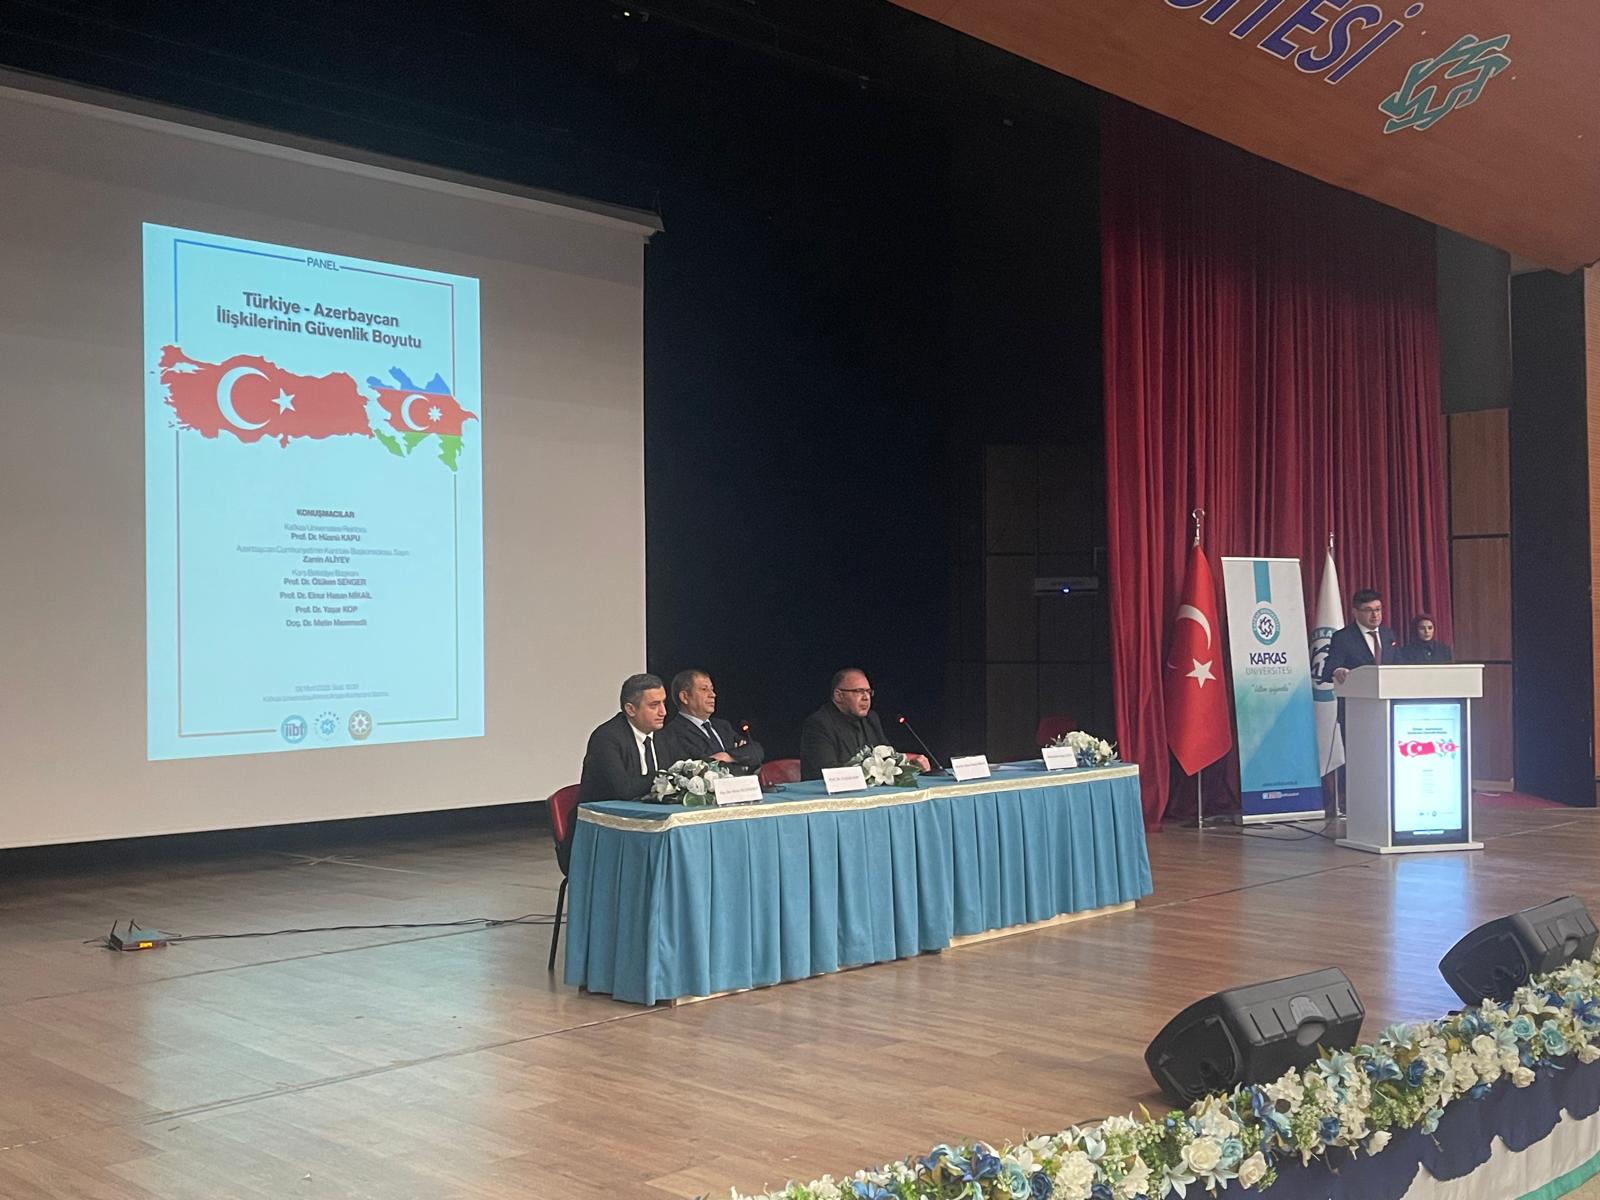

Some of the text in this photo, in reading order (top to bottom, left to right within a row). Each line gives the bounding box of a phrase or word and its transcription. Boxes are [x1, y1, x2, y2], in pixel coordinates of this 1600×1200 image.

[306, 257, 339, 271] PANEL
[242, 291, 301, 314] Türkiye
[313, 302, 399, 328] Azerbaycan
[216, 305, 422, 349] İlişkilerinin Güvenlik Boyutu
[296, 509, 355, 519] KONUŞMACILAR
[290, 533, 306, 541] Prof.
[308, 533, 318, 541] Dr.
[340, 534, 361, 542] KAPU
[283, 578, 301, 586] Prof.
[301, 578, 311, 586] Dr.
[296, 591, 307, 600] Dr.
[295, 605, 312, 614] Prof.
[312, 605, 323, 614] Dr.
[302, 619, 313, 628] Dr.
[1249, 652, 1287, 665] KAFKAS
